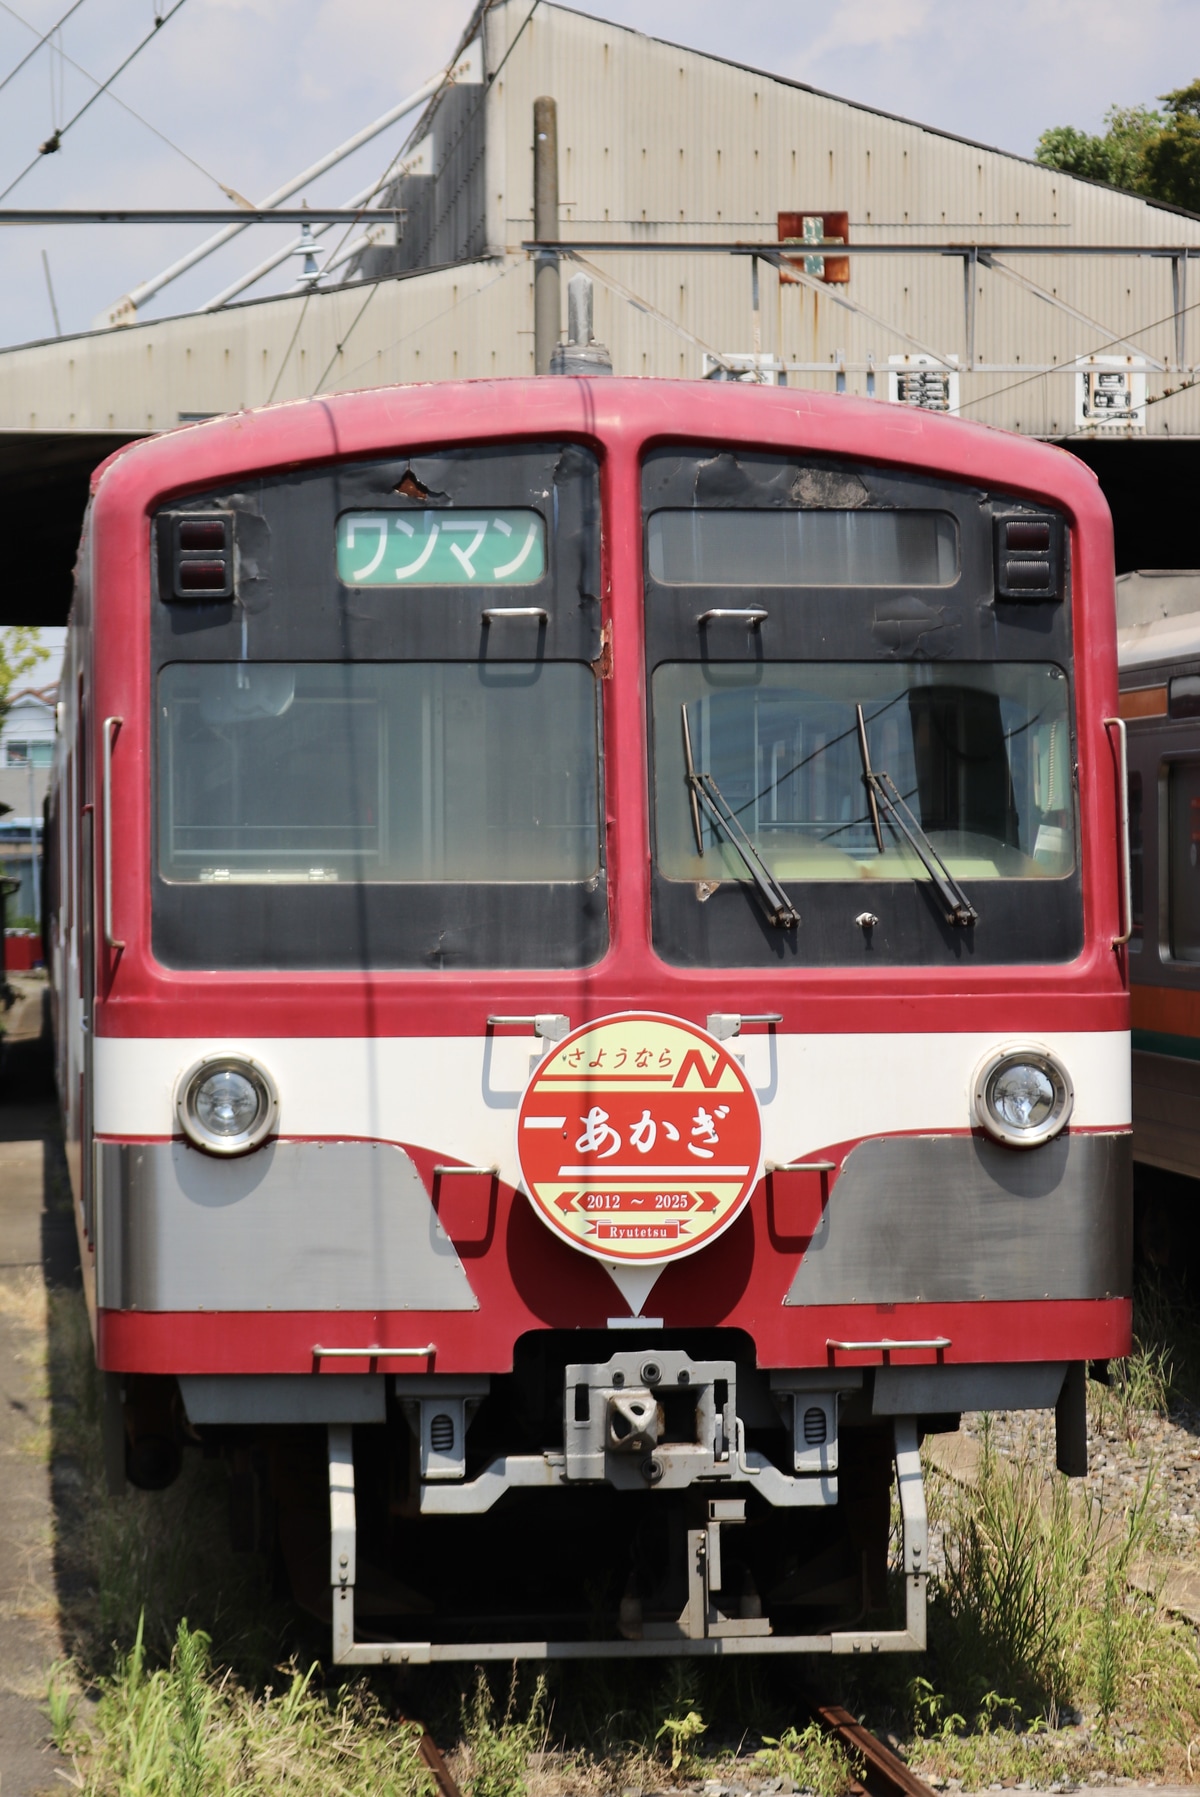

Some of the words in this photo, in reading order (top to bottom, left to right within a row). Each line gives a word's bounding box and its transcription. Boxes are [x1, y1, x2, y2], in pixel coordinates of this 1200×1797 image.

[346, 518, 538, 580] ワンマン
[568, 1048, 672, 1069] さようなら
[575, 1105, 730, 1159] あかぎ
[587, 1195, 620, 1209] 2012
[655, 1194, 688, 1209] 2025
[609, 1226, 668, 1239] Ryutetsu
